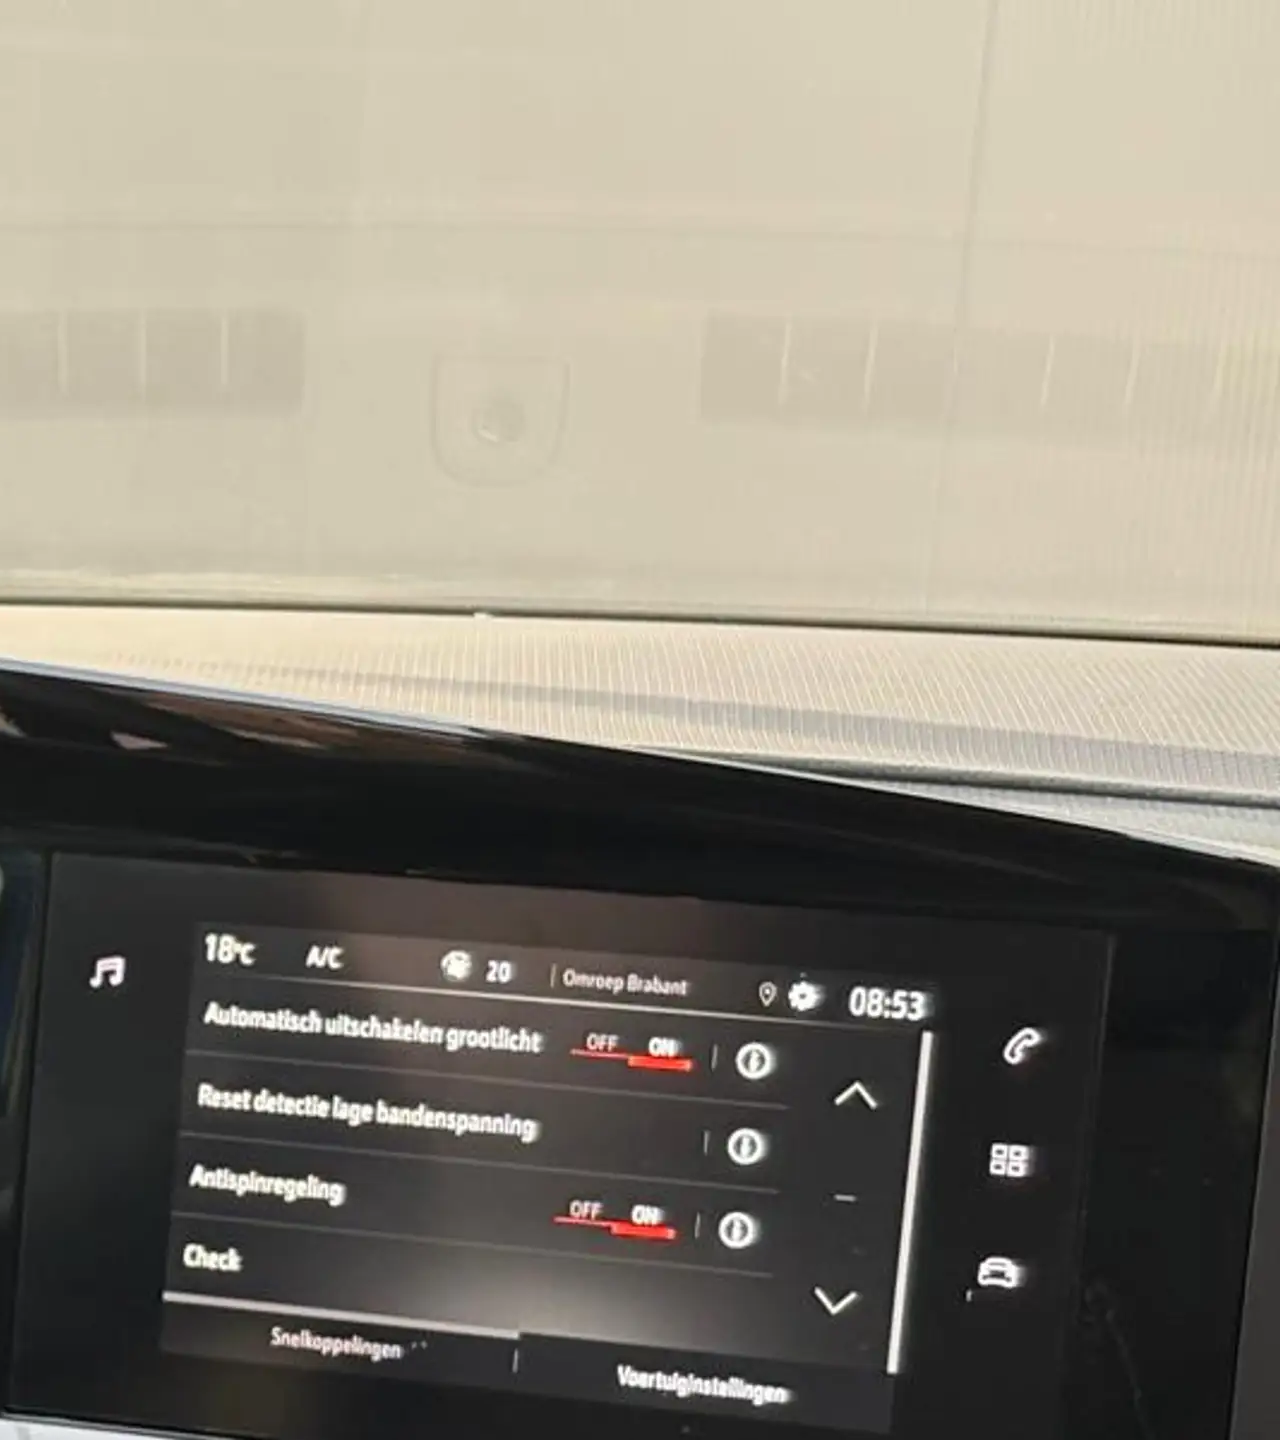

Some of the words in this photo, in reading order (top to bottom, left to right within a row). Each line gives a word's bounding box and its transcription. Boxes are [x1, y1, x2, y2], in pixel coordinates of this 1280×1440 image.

[305, 945, 345, 969] A/C
[485, 959, 512, 983] 20
[562, 969, 624, 994] Omroep
[627, 973, 688, 995] Brabant
[848, 986, 929, 1021] 08:53
[203, 1001, 322, 1034] Automatisch
[324, 1013, 443, 1044] uitschakelen
[445, 1025, 542, 1053] grootlicht
[586, 1033, 619, 1051] OFF
[648, 1036, 680, 1056] ON
[197, 1082, 251, 1112] Reset
[253, 1089, 330, 1118] detectie
[333, 1096, 374, 1127] lage
[376, 1100, 539, 1144] bandenspanning
[190, 1164, 346, 1207] Antispinregeling
[569, 1200, 603, 1220] OFF
[631, 1204, 663, 1225] ON
[183, 1243, 242, 1272] Check
[269, 1327, 403, 1361] Snelkoppelingen
